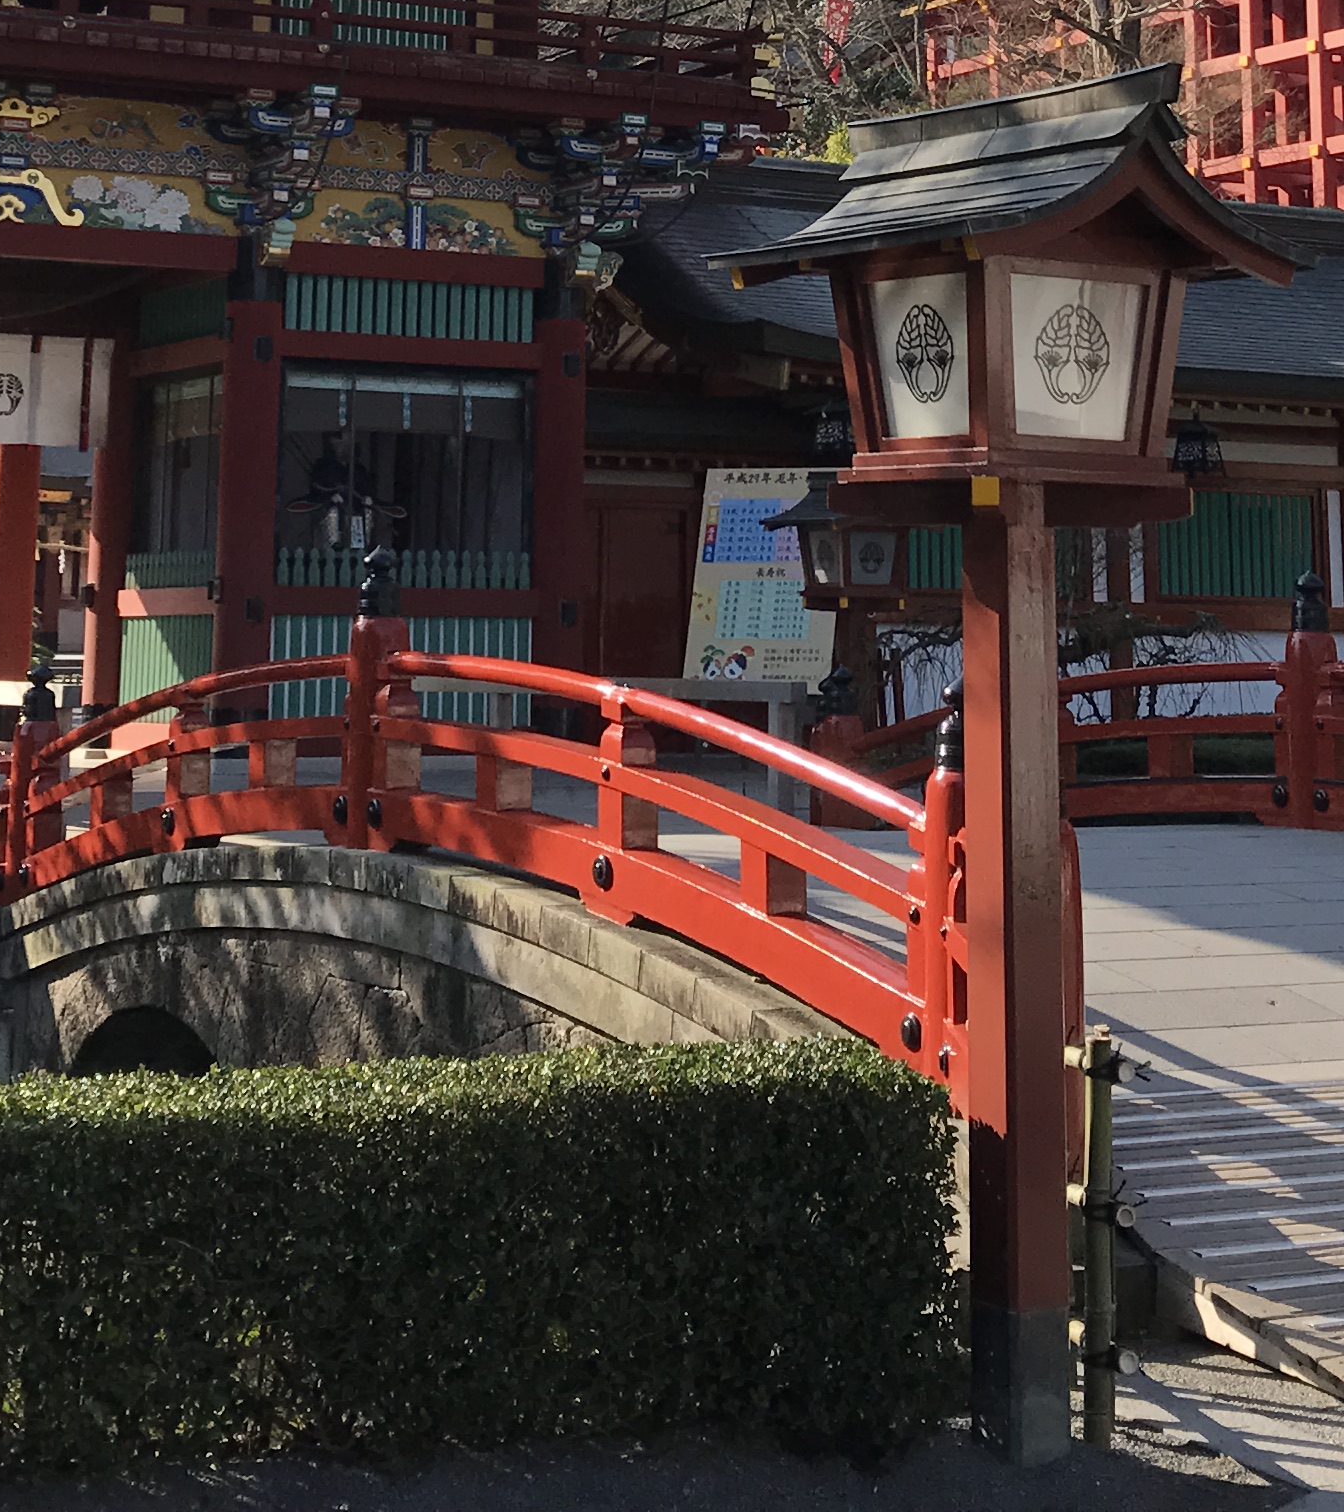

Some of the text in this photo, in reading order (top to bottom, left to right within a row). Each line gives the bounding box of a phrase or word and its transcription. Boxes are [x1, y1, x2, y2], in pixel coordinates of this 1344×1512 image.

[723, 472, 772, 484] 平成29年
[756, 567, 786, 578] 長寿祝
